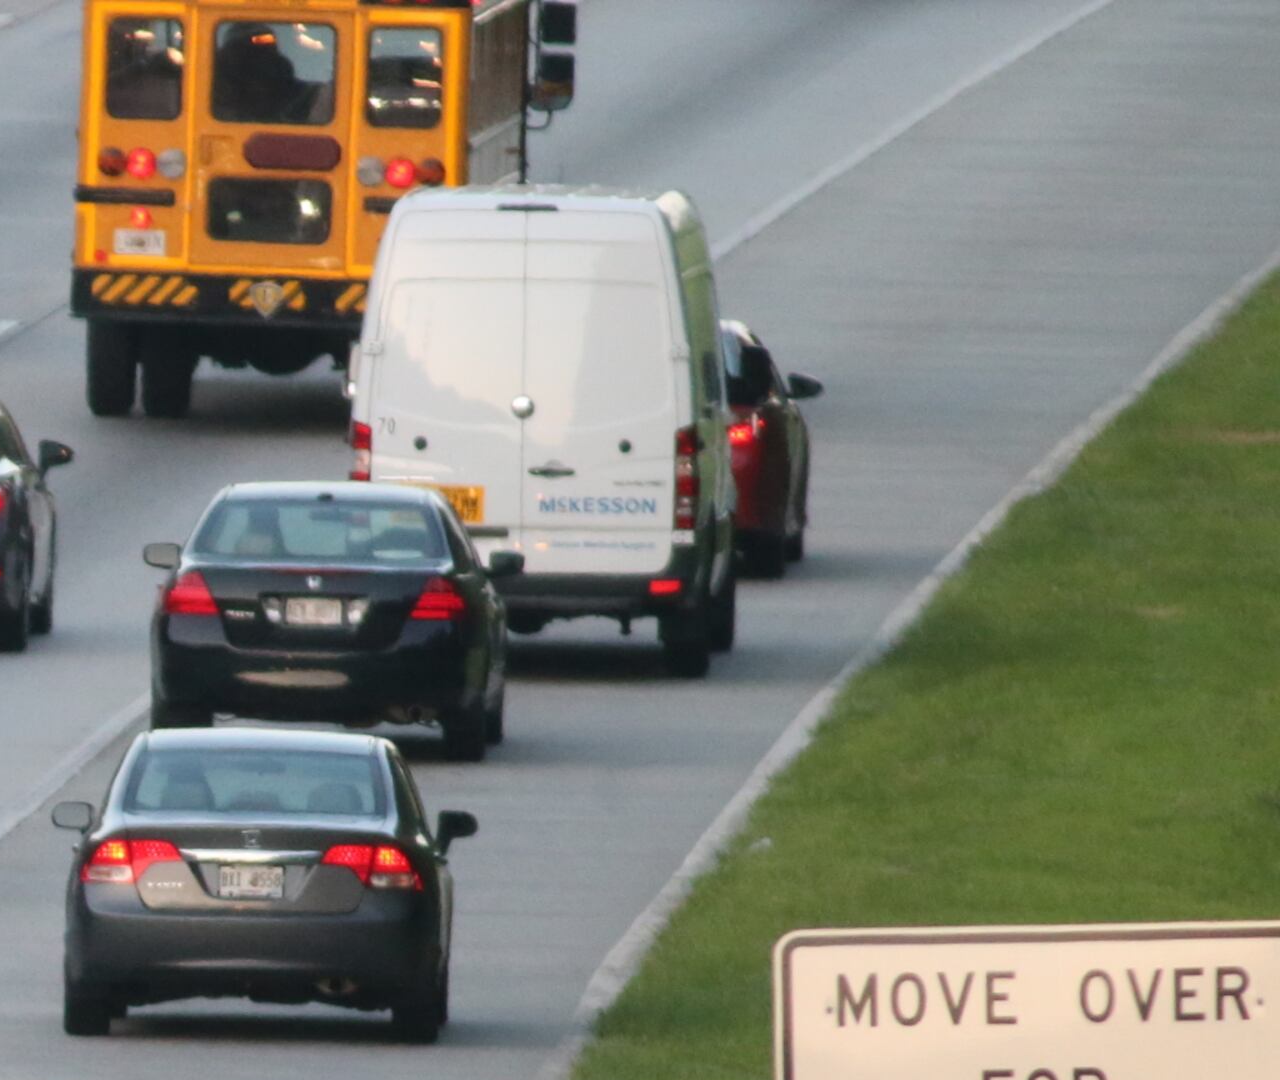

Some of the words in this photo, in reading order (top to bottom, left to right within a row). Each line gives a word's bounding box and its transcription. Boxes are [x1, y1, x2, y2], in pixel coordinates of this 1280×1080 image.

[378, 417, 396, 434] 70
[837, 971, 1018, 1027] MOVE
[1079, 966, 1251, 1022] OVER
